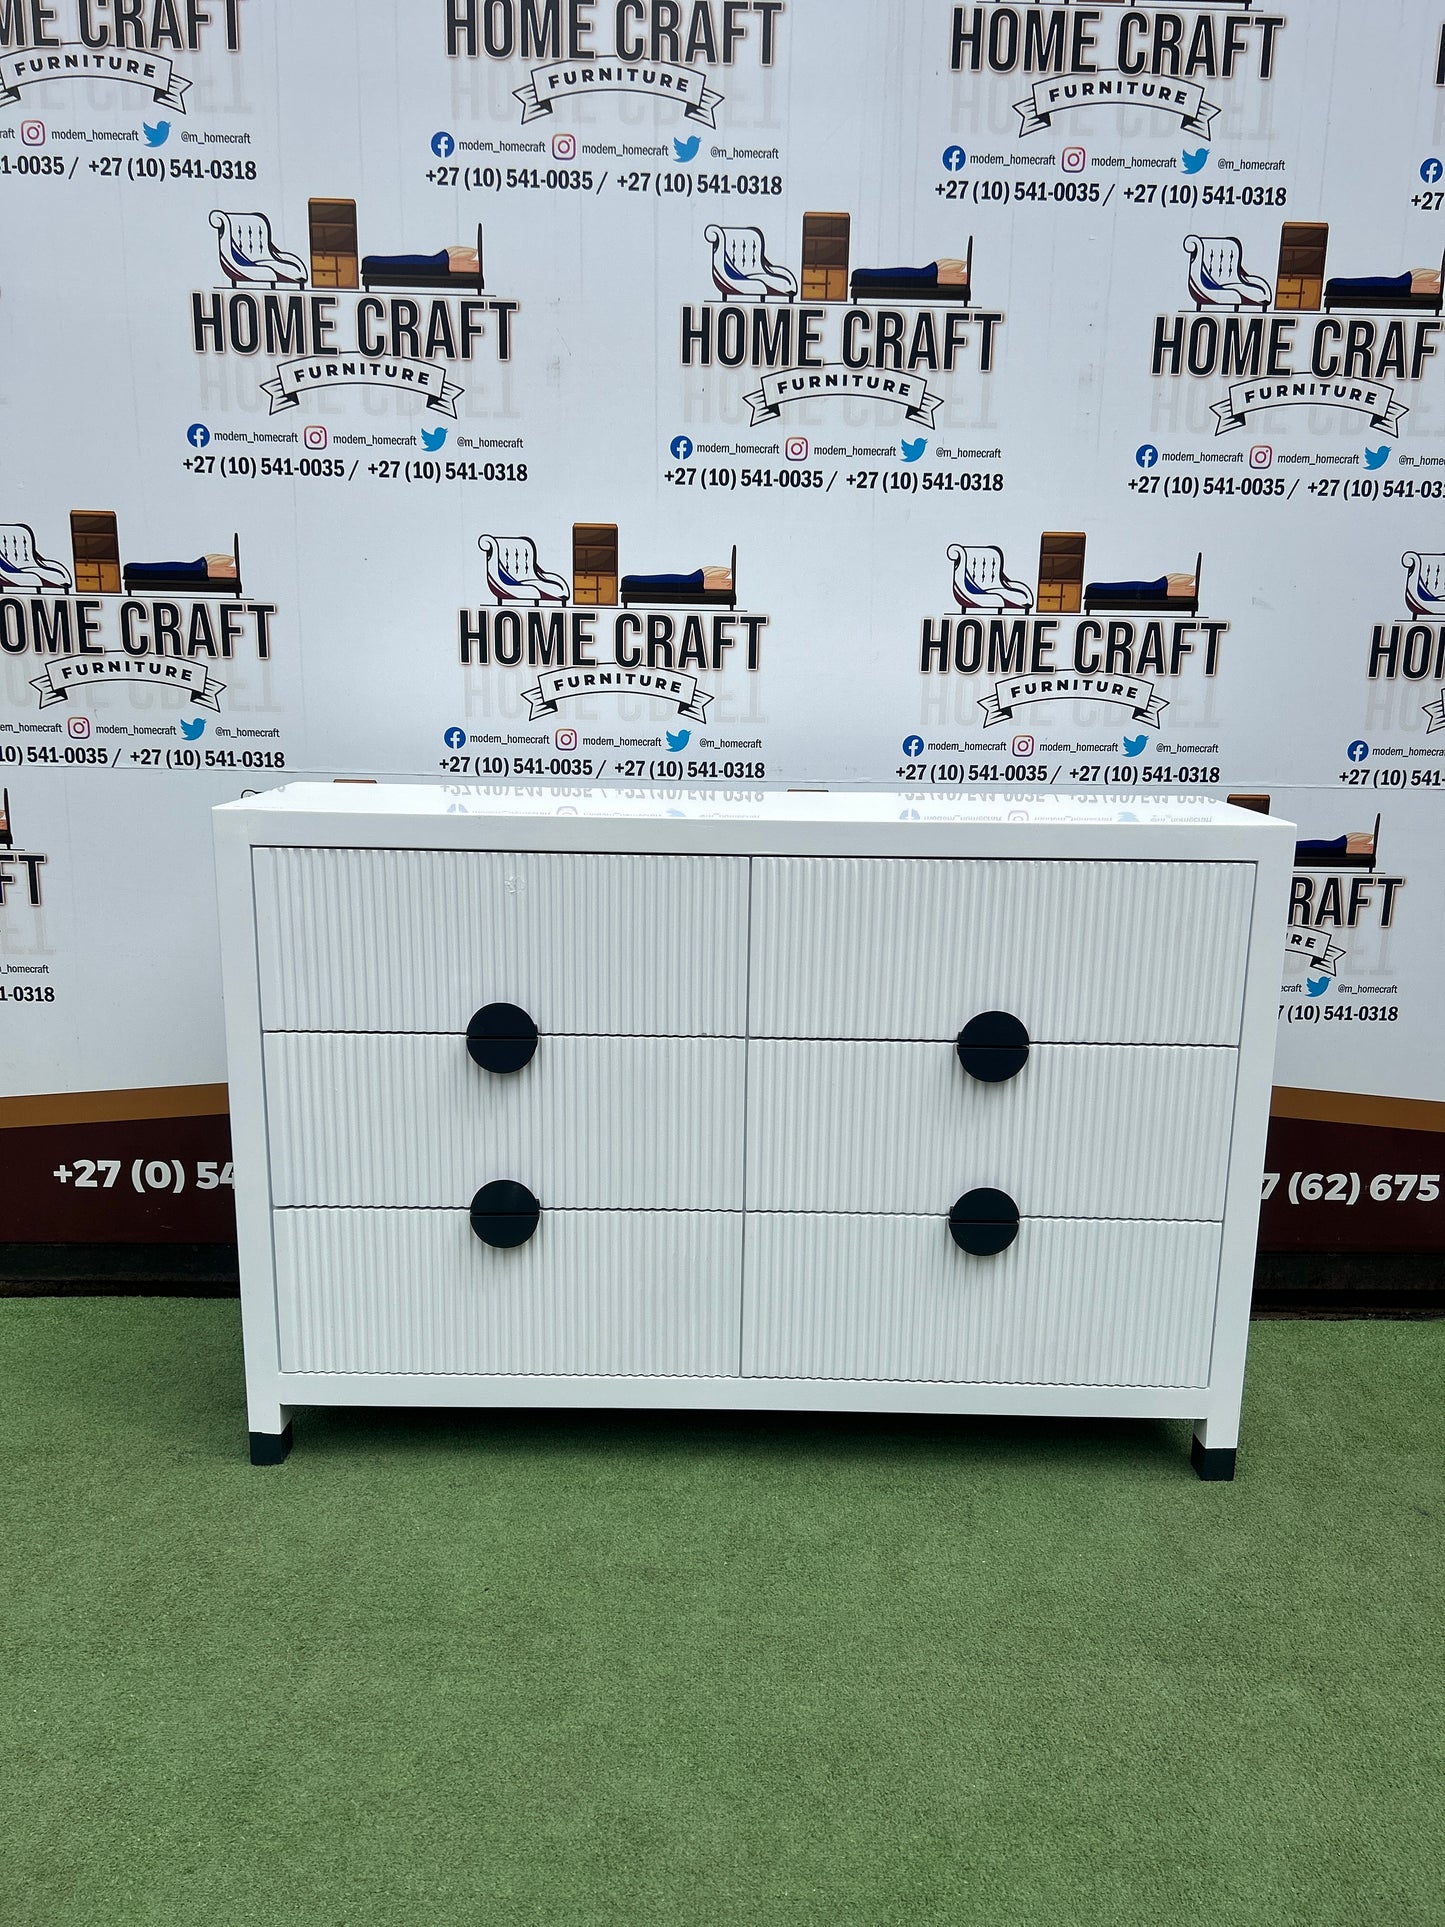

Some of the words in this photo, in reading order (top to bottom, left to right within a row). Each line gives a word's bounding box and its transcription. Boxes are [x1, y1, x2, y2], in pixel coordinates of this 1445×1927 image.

[79, 0, 240, 51] CRAFT
[446, 0, 595, 60] HOME
[615, 0, 783, 65] CRAFT
[951, 7, 1101, 75] HOME
[1118, 12, 1285, 80] CRAFT
[14, 55, 155, 78] FURNITURE
[548, 68, 688, 92] FURNITURE
[1049, 81, 1187, 105] FURNITURE
[181, 131, 251, 144] @m_homecraft
[710, 146, 779, 160] @m_homecraft
[0, 155, 64, 175] 1-0035
[89, 157, 122, 176] +27
[128, 158, 165, 182] (10)
[170, 159, 256, 180] 541-0318
[1218, 158, 1285, 171] @m_homecraft
[426, 167, 459, 186] +27
[465, 168, 501, 192] (10)
[506, 169, 593, 190] 541-0035
[617, 172, 651, 191] +27
[656, 173, 692, 197] (10)
[697, 174, 782, 195] 541-0318
[935, 180, 969, 199] +27
[973, 181, 1009, 205] (10)
[1014, 182, 1099, 202] 541-0035
[1124, 184, 1157, 203] +27
[1161, 185, 1198, 208] (10)
[1202, 186, 1286, 206] 541-0318
[1411, 192, 1444, 210] +27
[192, 292, 339, 355] HOME
[356, 297, 518, 361] CRAFT
[681, 305, 824, 368] HOME
[842, 310, 1002, 372] CRAFT
[1151, 316, 1296, 377] HOME
[294, 363, 429, 385] FURNITURE
[777, 374, 910, 396] FURNITURE
[1245, 384, 1377, 405] FURNITURE
[457, 437, 523, 449] @m_homecraft
[936, 447, 1001, 459] @m_homecraft
[183, 456, 215, 473] +27
[221, 457, 256, 479] (10)
[261, 458, 344, 477] 541-0035
[368, 460, 400, 478] +27
[405, 461, 441, 483] (10)
[445, 462, 527, 481] 541-0318
[664, 468, 696, 485] +27
[701, 468, 736, 490] (10)
[741, 469, 823, 488] 541-0035
[846, 471, 878, 489] +27
[883, 472, 918, 494] (10)
[922, 473, 1003, 491] 541-0318
[1128, 476, 1160, 493] +27
[1164, 476, 1199, 498] (10)
[1203, 477, 1285, 496] 541-0035
[1308, 479, 1340, 496] +27
[1344, 480, 1378, 501] (10)
[1383, 480, 1445, 498] 541-03
[121, 601, 276, 659] CRAFT
[459, 609, 597, 666] HOME
[615, 613, 767, 670] CRAFT
[920, 618, 1060, 674] HOME
[1073, 620, 1229, 676] CRAFT
[1367, 625, 1445, 680] HO
[62, 661, 192, 681] FURNITURE
[554, 673, 681, 693] FURNITURE
[1011, 680, 1138, 699] FURNITURE
[215, 727, 280, 738] @m_homecraft
[699, 738, 762, 749] @m_homecraft
[27, 746, 108, 764] 541-0035
[130, 749, 161, 765] +27
[166, 749, 201, 768] (10)
[205, 750, 285, 768] 541-0318
[1156, 743, 1218, 754] @m_homecraft
[437, 756, 470, 777] +27
[473, 757, 509, 777] (10)
[513, 758, 592, 775] 541-0035
[615, 760, 645, 776] +27
[650, 761, 683, 777] (10)
[687, 762, 765, 777] 541-0318
[896, 764, 927, 780] +27
[931, 764, 964, 783] (10)
[968, 765, 1047, 781] 541-0035
[1069, 765, 1100, 781] +27
[1104, 766, 1138, 783] (10)
[1142, 766, 1220, 783] 541-0318
[1339, 769, 1370, 785] +27
[1373, 769, 1407, 788] (10)
[0, 964, 49, 974] _homecraft
[1338, 984, 1397, 994] @m_homecraft
[1288, 1005, 1320, 1023] (10)
[1324, 1006, 1398, 1021] 541-0318
[53, 1159, 123, 1188] +27
[131, 1159, 186, 1194] (0)
[1287, 1171, 1361, 1206] (62)
[1369, 1172, 1441, 1203] 675
